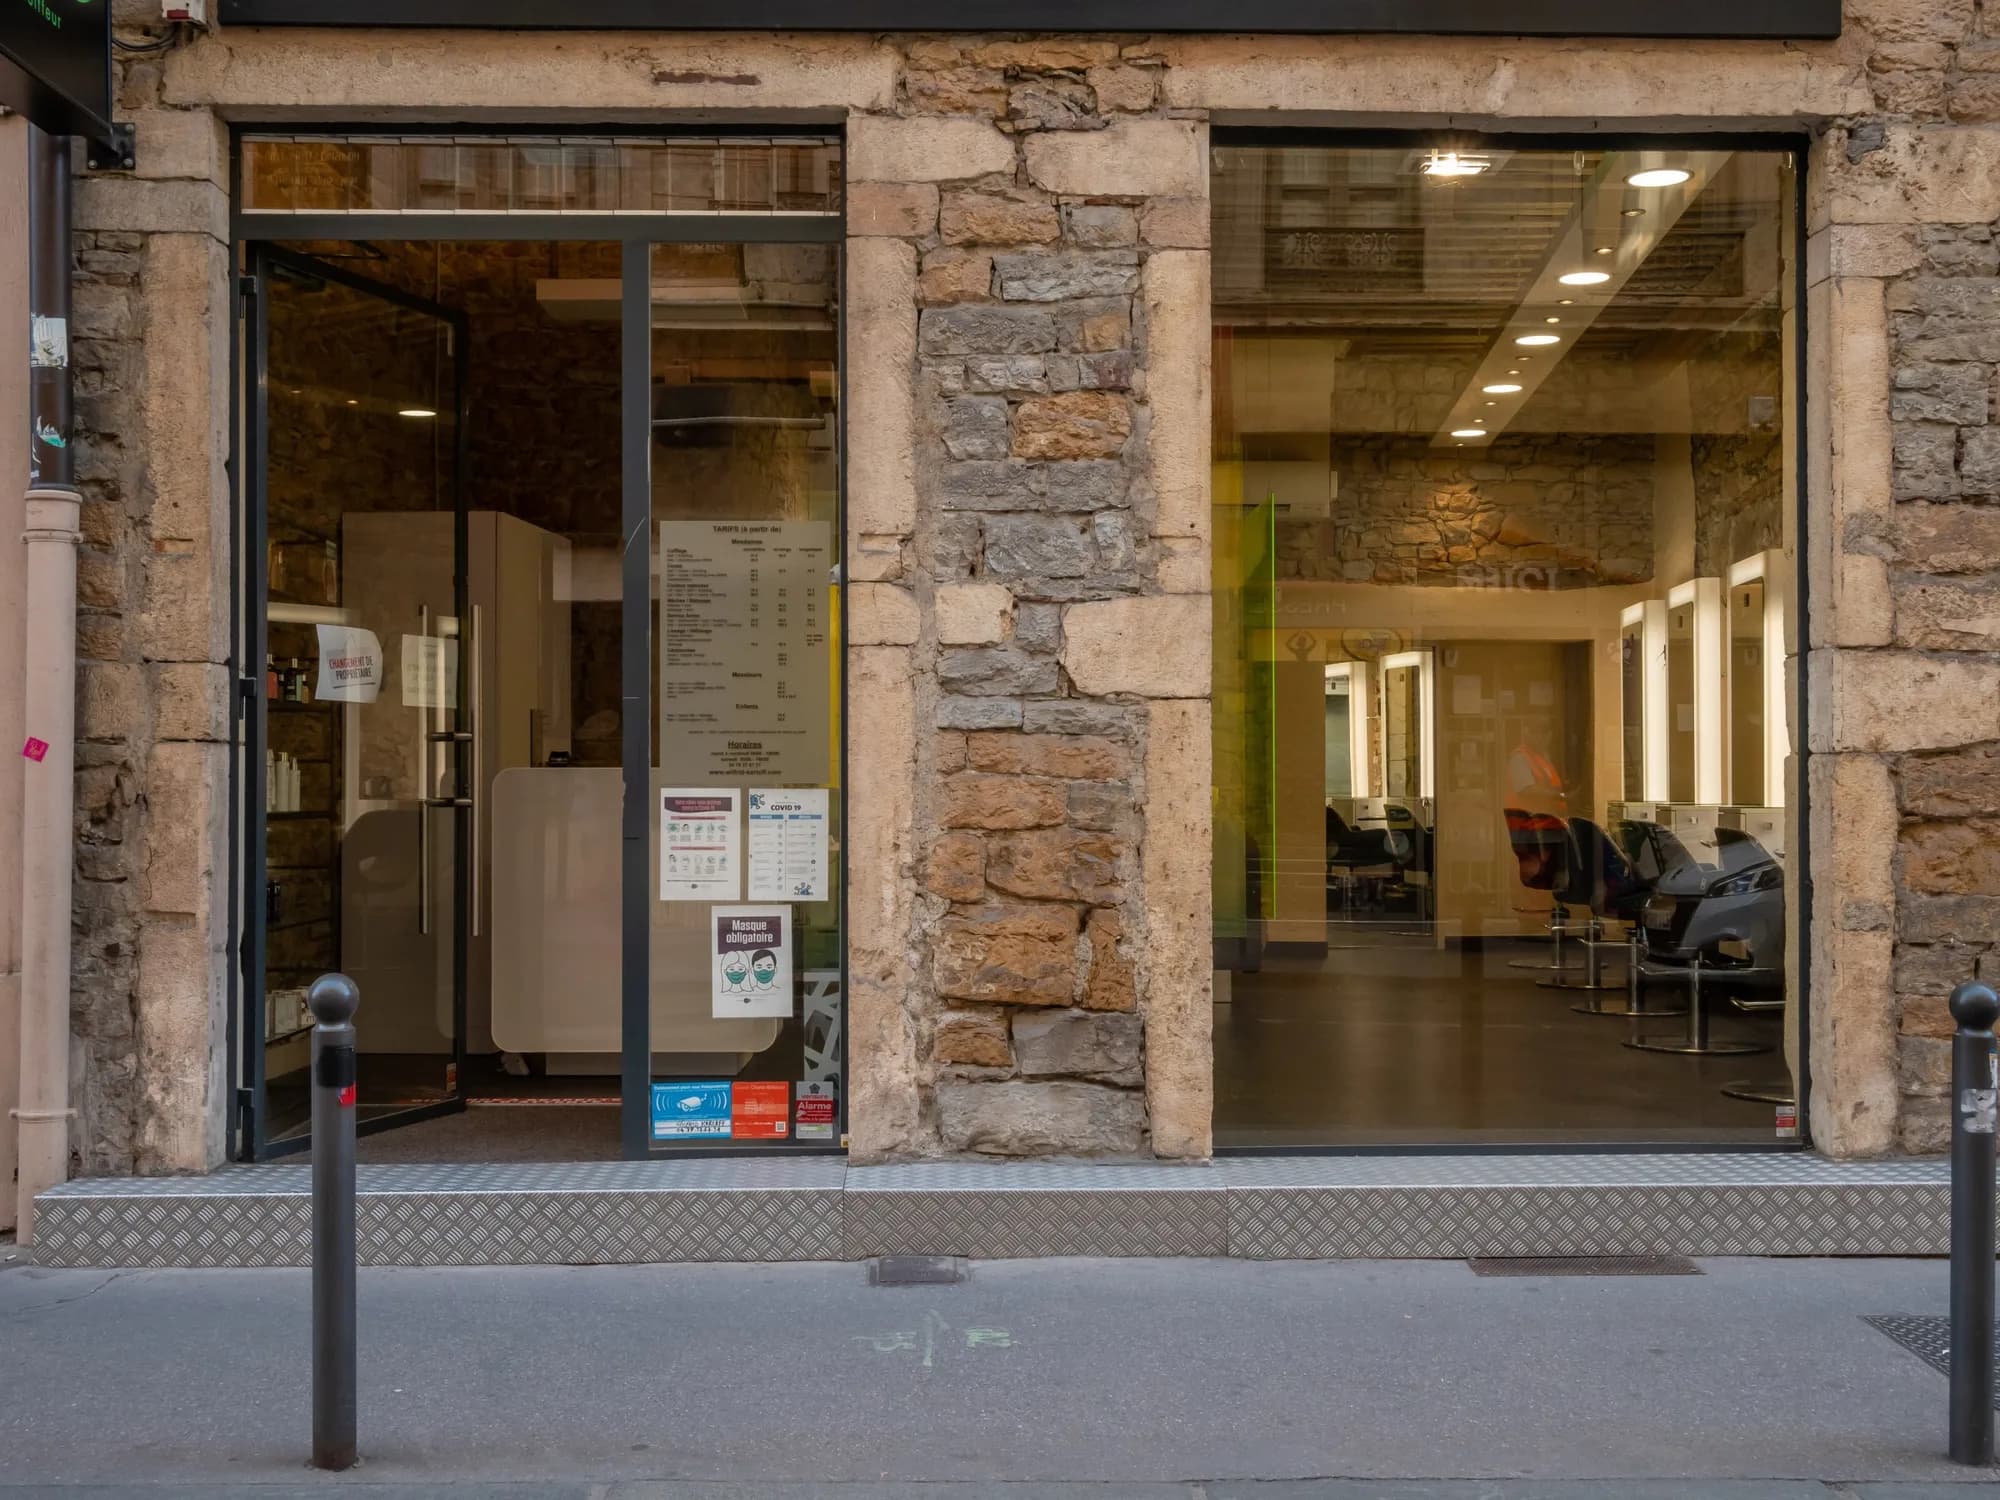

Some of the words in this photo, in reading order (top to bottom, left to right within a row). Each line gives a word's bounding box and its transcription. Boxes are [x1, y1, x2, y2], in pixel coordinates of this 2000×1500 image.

[712, 525, 740, 533] TARIFS
[727, 740, 762, 750] Horaires
[731, 919, 768, 932] Masque
[725, 931, 774, 945] obligatoire
[797, 1101, 832, 1110] Alarme
